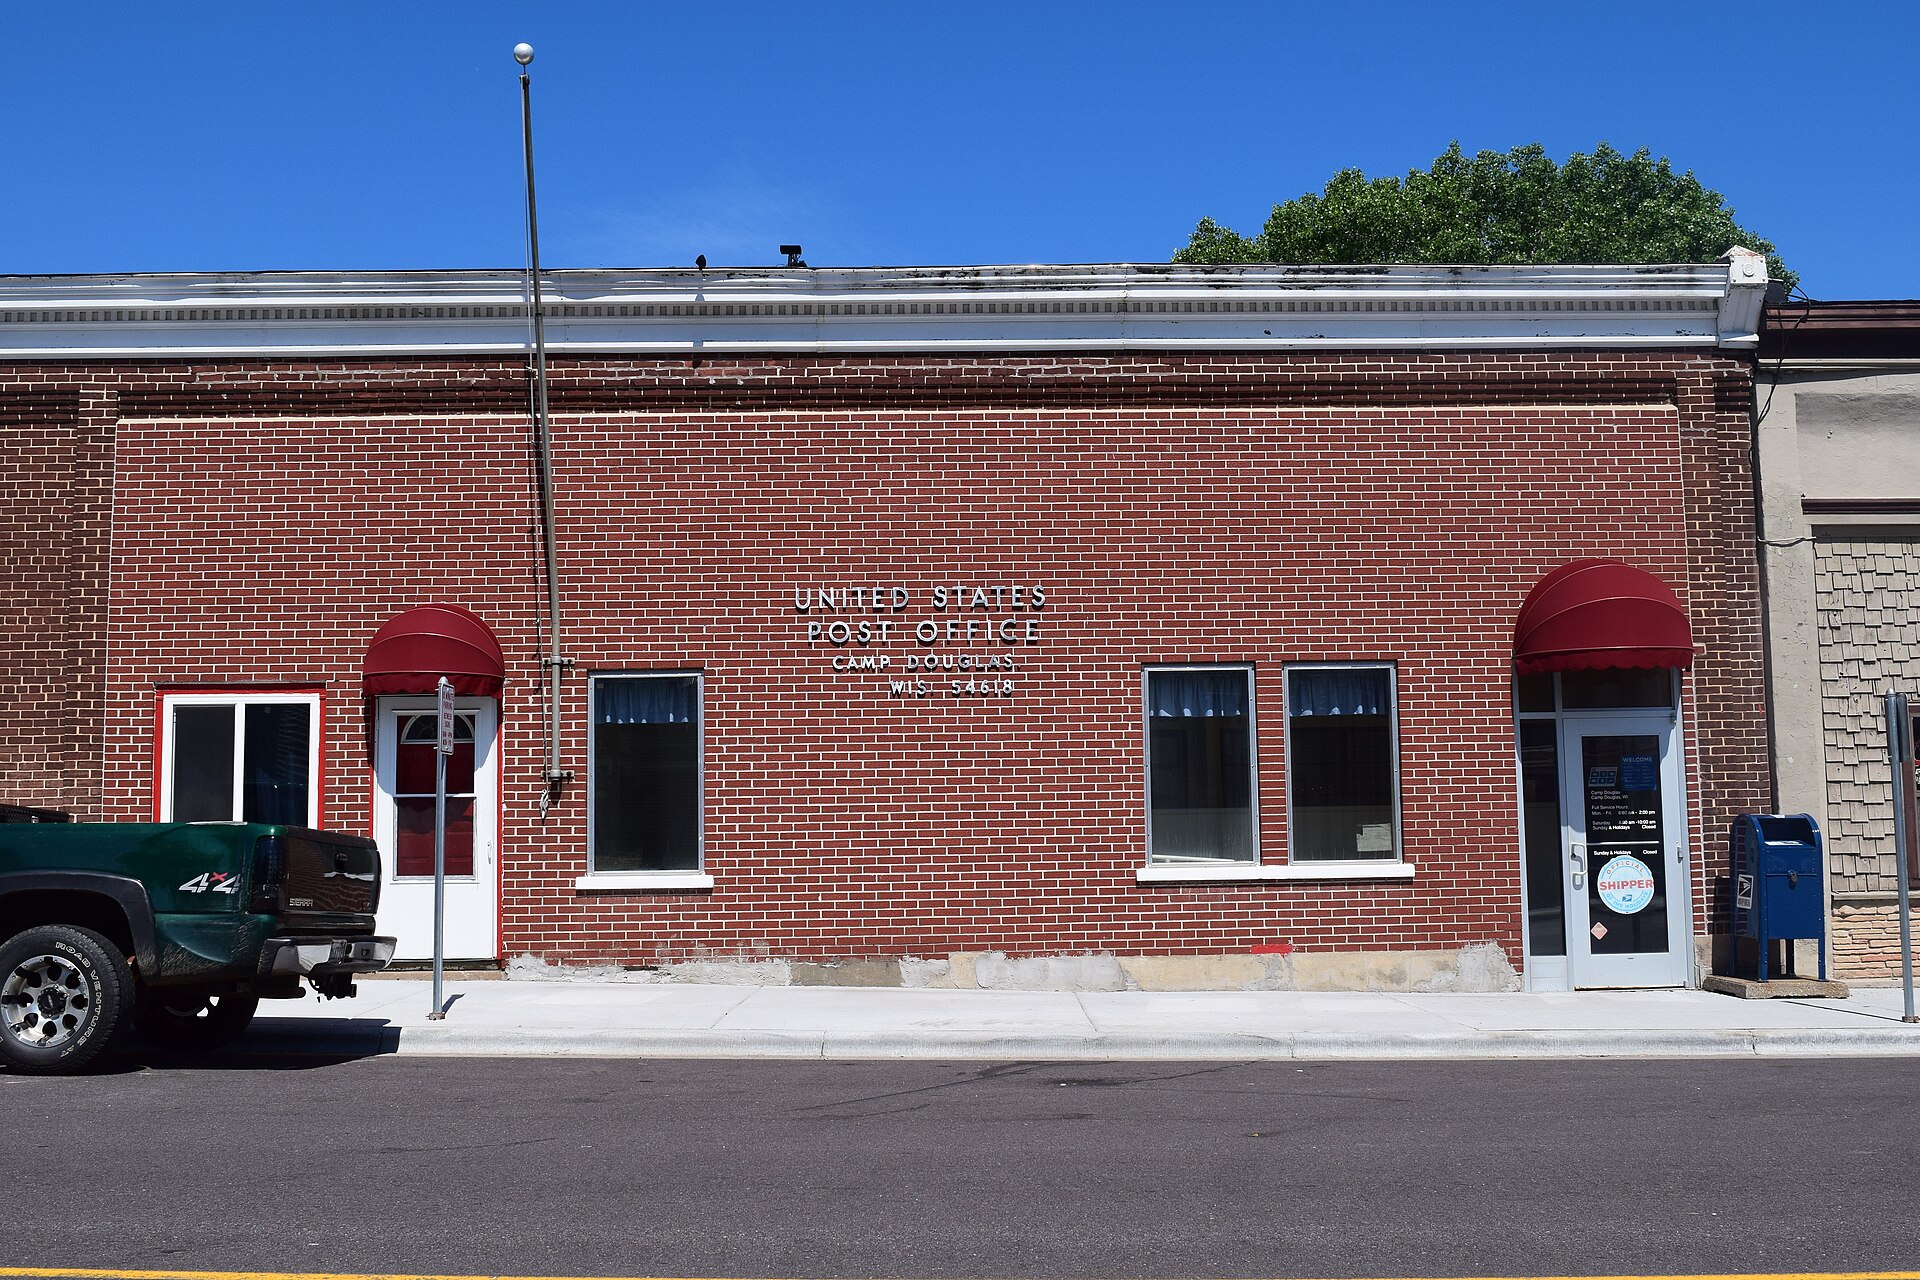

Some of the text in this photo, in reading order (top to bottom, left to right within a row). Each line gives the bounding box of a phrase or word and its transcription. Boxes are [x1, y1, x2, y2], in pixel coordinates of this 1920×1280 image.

[795, 585, 1046, 610] UNITED STATES
[808, 618, 1039, 643] POST OFFICE
[832, 655, 890, 670] CAMP
[951, 679, 1013, 695] 54618
[1606, 860, 1645, 875] OFFICIAL
[1599, 879, 1654, 891] SHIPPER
[289, 897, 314, 907] SIERRA
[1624, 891, 1649, 909] HOLIDAYS
[55, 941, 102, 1058] ROAD VENTURE AT
